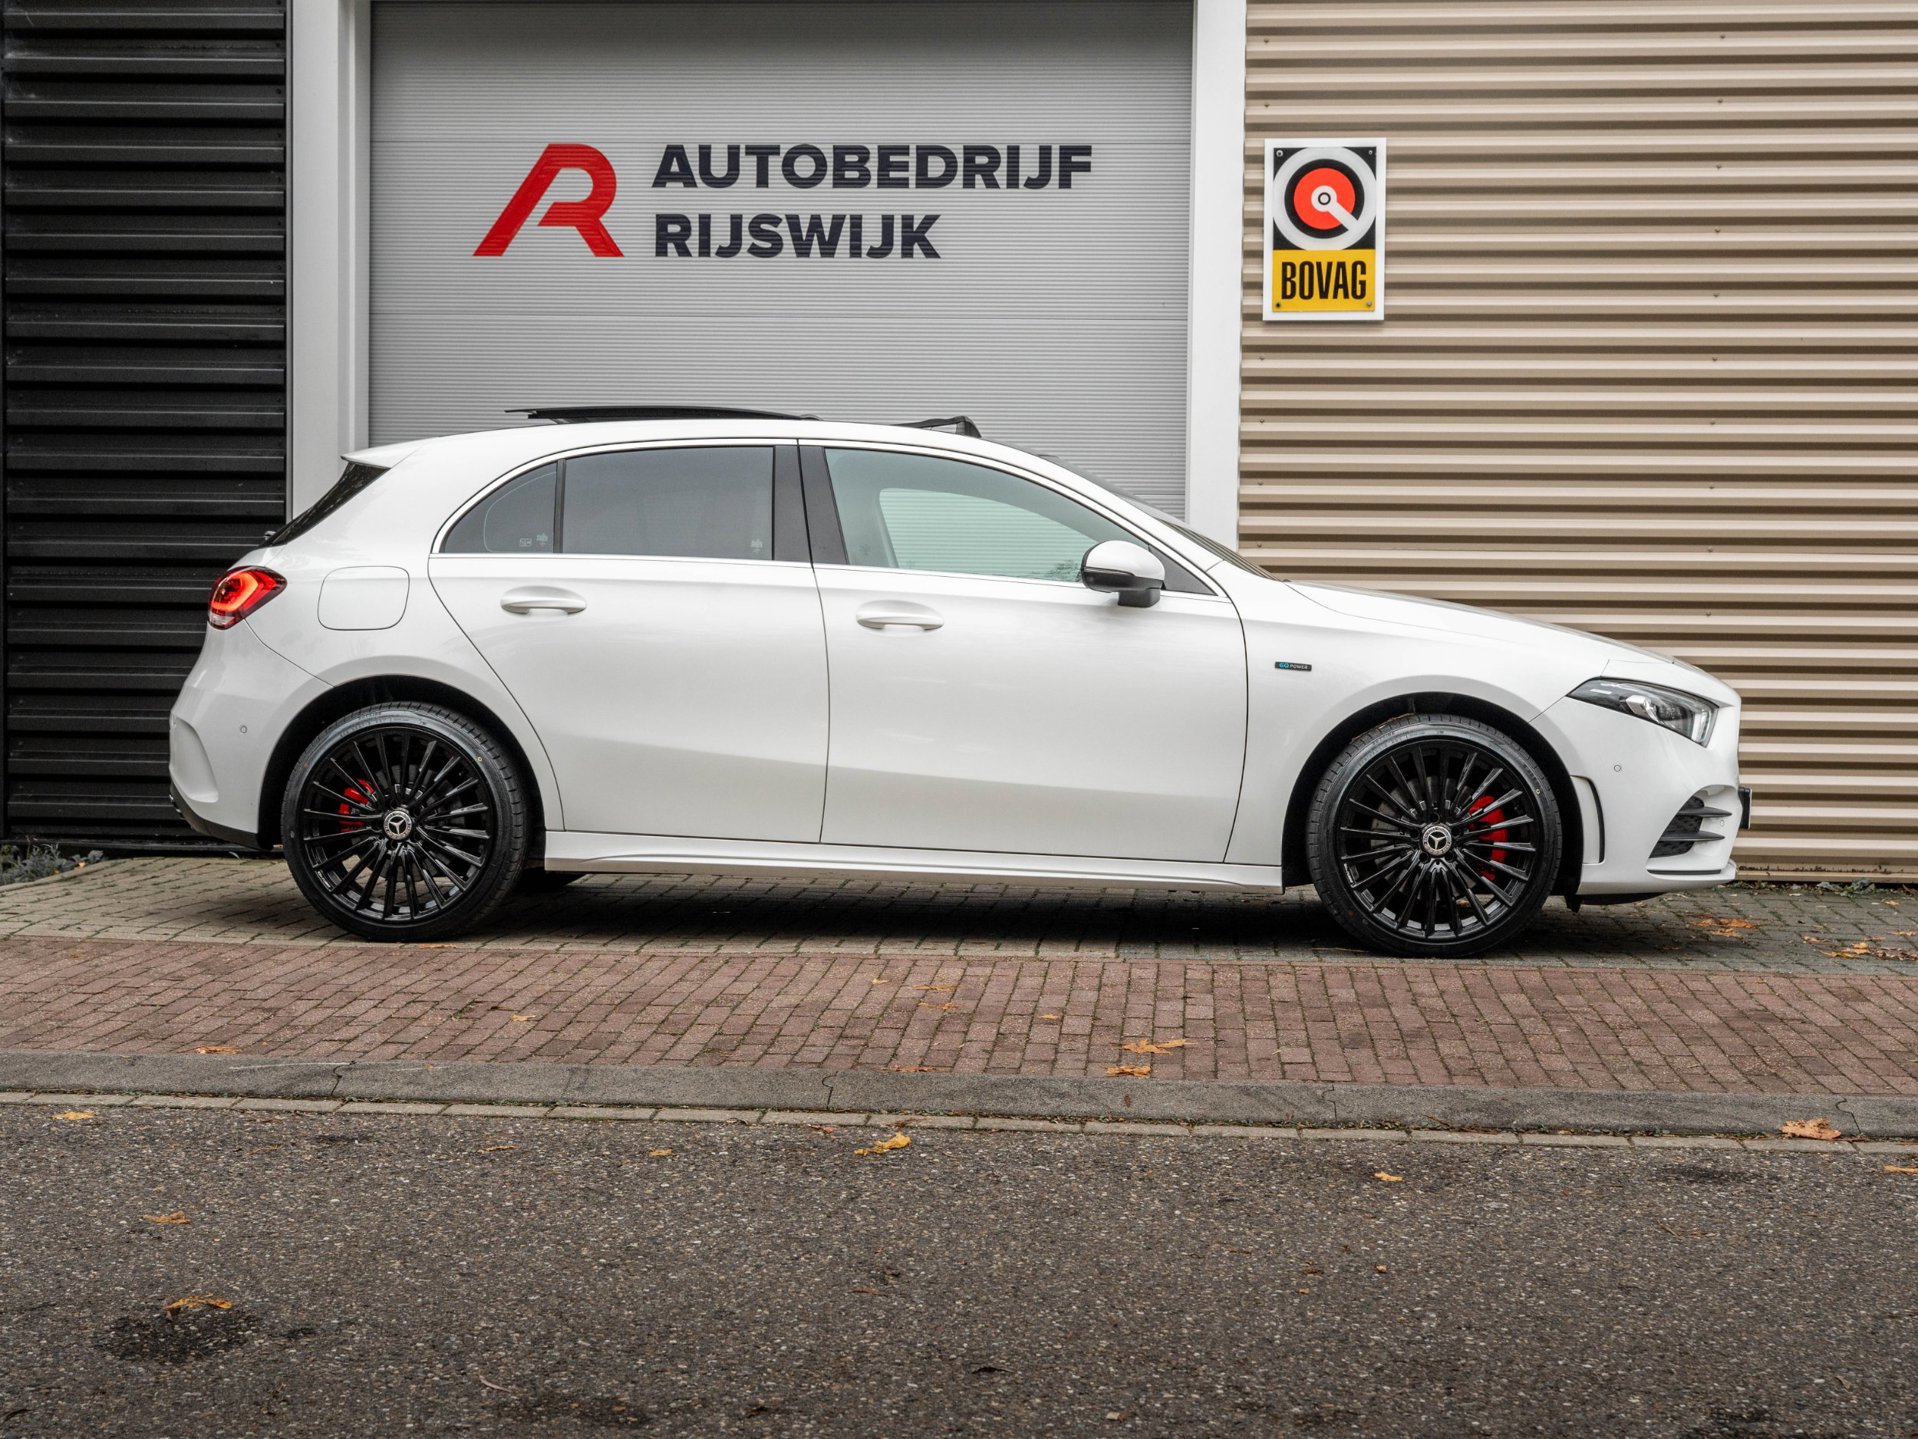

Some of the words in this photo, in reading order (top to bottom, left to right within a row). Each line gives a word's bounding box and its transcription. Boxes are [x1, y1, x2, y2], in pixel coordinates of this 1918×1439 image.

[652, 144, 1093, 189] AUTOBEDRIJF
[655, 213, 942, 259] RIJSWIJK
[1281, 260, 1367, 300] BOVAG
